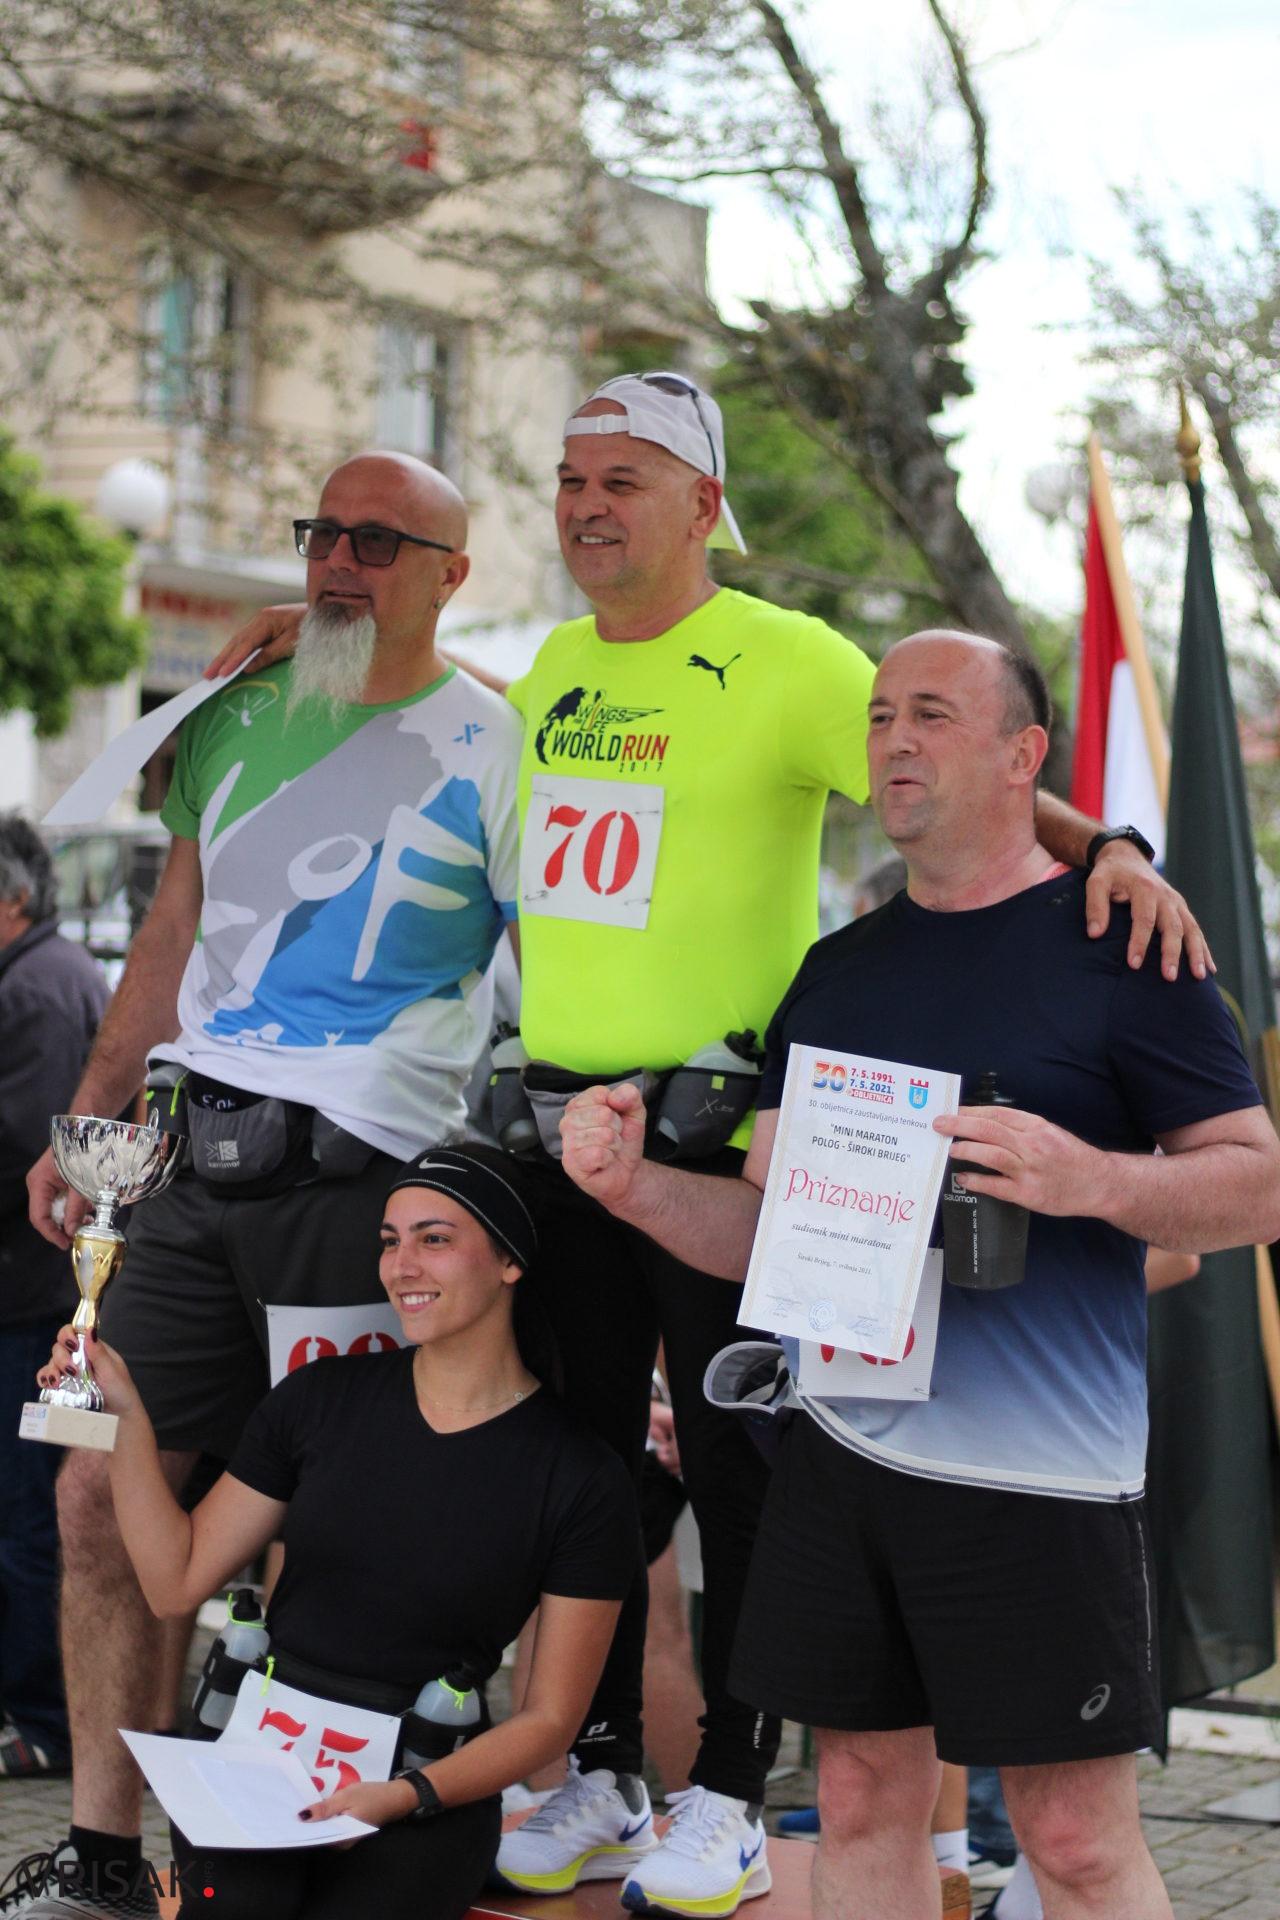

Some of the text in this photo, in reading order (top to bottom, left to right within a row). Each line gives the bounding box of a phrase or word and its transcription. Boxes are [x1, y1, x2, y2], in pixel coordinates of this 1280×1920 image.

[619, 762, 663, 773] 2017
[544, 805, 640, 895] 70
[812, 1060, 847, 1094] 30
[871, 1071, 896, 1084] 1991.
[853, 1090, 893, 1103] OBLJETNICA
[870, 1082, 895, 1095] 2021.
[820, 1101, 853, 1115] obljetnica
[854, 1108, 899, 1124] zaustavljanja
[899, 1117, 928, 1129] tenkova
[812, 1136, 840, 1150] POLOG
[847, 1140, 876, 1157] ŠIROKI
[855, 1129, 898, 1146] MARATON
[783, 1167, 916, 1226] Priznanje
[944, 1193, 977, 1204] salomon
[792, 1222, 892, 1251] sudionik mini maratona
